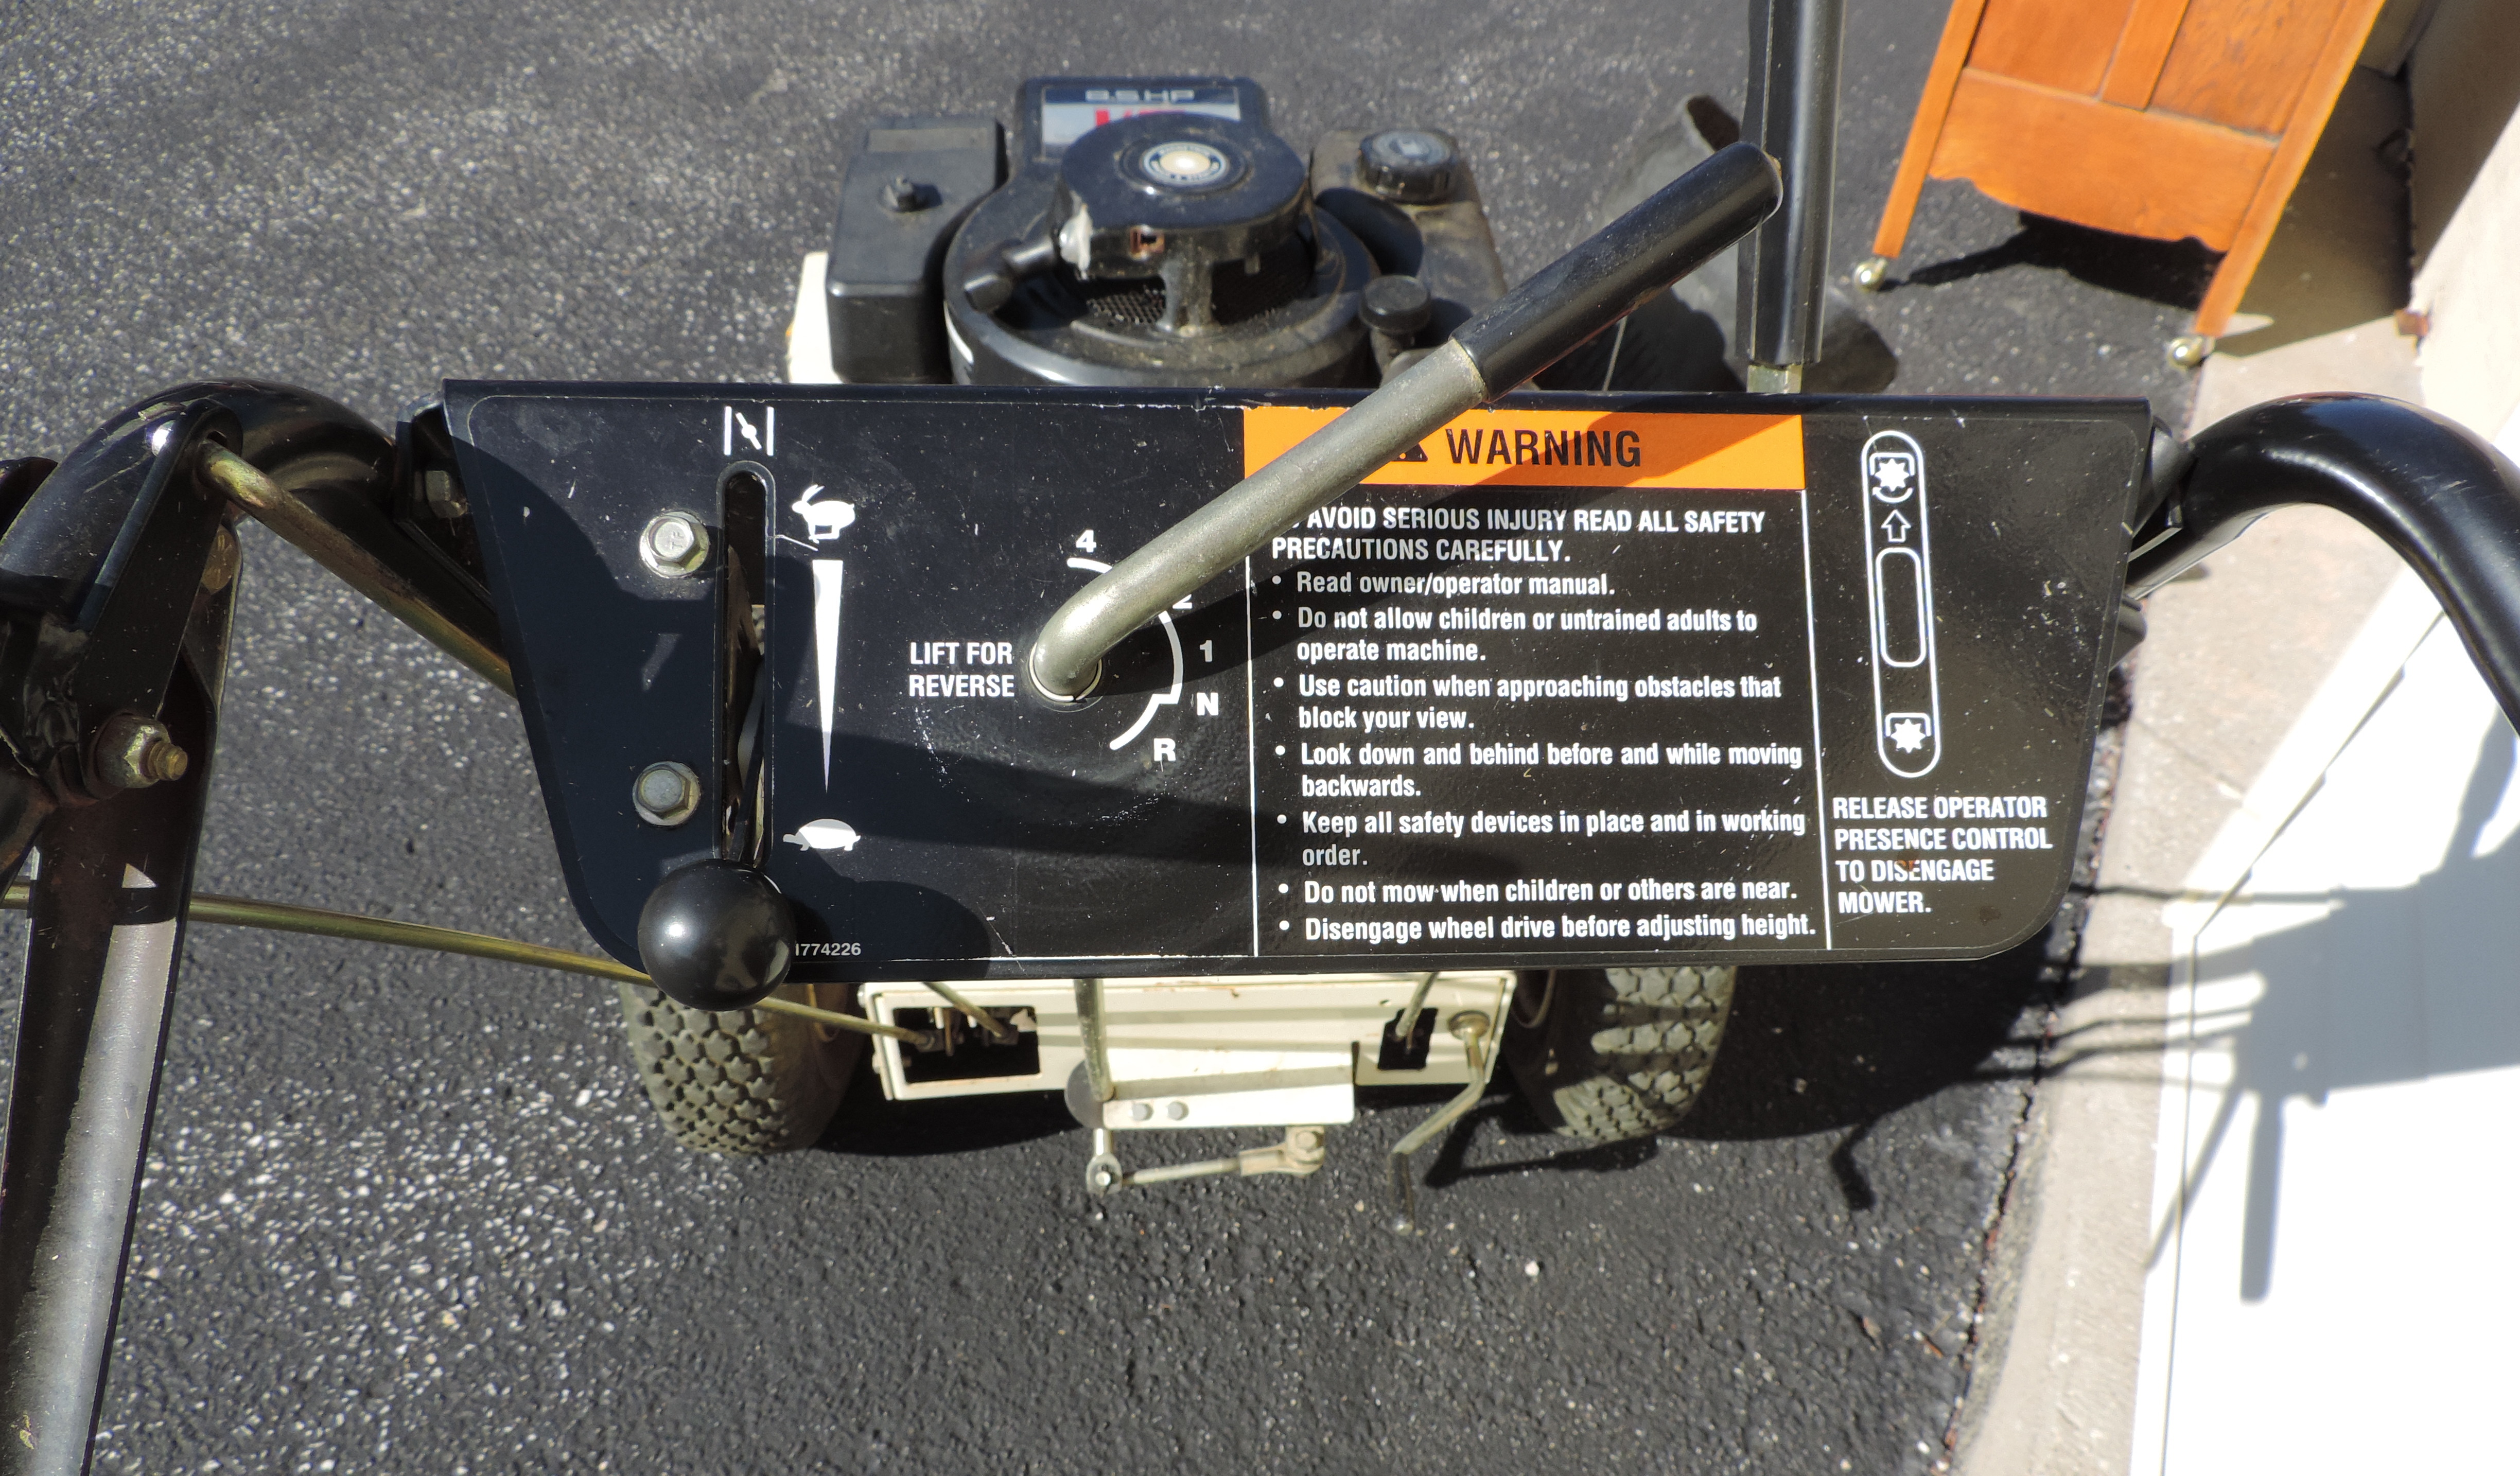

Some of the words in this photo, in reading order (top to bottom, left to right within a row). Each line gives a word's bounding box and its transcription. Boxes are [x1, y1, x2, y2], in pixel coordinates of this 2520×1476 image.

[1446, 429, 1640, 467] WARNING
[1307, 506, 1376, 529] AVOID
[1383, 506, 1479, 529] SERIOUS
[1487, 509, 1567, 531] INJURY
[1573, 509, 1632, 533] READ
[1636, 509, 1679, 533] ALL
[1684, 510, 1765, 533] SAFETY
[1075, 530, 1097, 553] 4
[1272, 536, 1428, 560] PRECAUTIONS
[1437, 539, 1570, 563] CAREFULLY.
[1298, 572, 1351, 592] Read
[1360, 573, 1522, 599] owner/operator
[1528, 573, 1615, 595] manual.
[1299, 607, 1326, 628] Do
[1334, 608, 1368, 629] not
[1374, 606, 1432, 630] allow
[1439, 607, 1526, 630] children
[1532, 612, 1554, 630] or
[1561, 608, 1661, 631] untrained
[1667, 608, 1732, 631] adults
[1736, 610, 1758, 632] to
[910, 641, 960, 666] LIFT
[966, 641, 1014, 665] FOR
[1200, 640, 1212, 662] 1
[1297, 639, 1379, 665] operate
[1386, 638, 1485, 661] machine.
[908, 673, 1014, 698] REVERSE
[1299, 673, 1340, 697] Use
[1347, 674, 1426, 697] caution
[1432, 674, 1490, 697] when
[1497, 675, 1629, 702] approaching
[1634, 675, 1736, 698] obstacles
[1740, 676, 1782, 698] that
[1196, 692, 1220, 717] N
[1297, 706, 1357, 729] block
[1362, 711, 1411, 733] your
[1416, 706, 1474, 729] view.
[1153, 737, 1177, 762] R
[1301, 742, 1351, 765] Look
[1359, 743, 1414, 765] down
[1423, 743, 1461, 765] and
[1469, 742, 1539, 765] behind
[1547, 743, 1613, 765] before
[1621, 743, 1659, 765] and
[1666, 743, 1721, 765] while
[1728, 743, 1802, 769] moving
[1301, 774, 1421, 797] backwards.
[1832, 796, 1928, 819] RELEASE
[1933, 796, 2047, 819] OPERATOR
[1303, 811, 1357, 837] Keep
[1364, 811, 1392, 833] all
[1399, 811, 1464, 838] safety
[1471, 811, 1553, 833] devices
[1560, 810, 1580, 833] in
[1586, 809, 1644, 837] place
[1650, 810, 1690, 832] and
[1696, 810, 1717, 832] in
[1721, 809, 1806, 837] working
[1834, 827, 1948, 852] PRESENCE
[1951, 827, 2054, 851] CONTROL
[1303, 844, 1367, 866] order.
[1834, 859, 1866, 884] TO
[1870, 858, 1995, 883] DISENGAGE
[1305, 881, 1334, 904] Do
[1341, 881, 1376, 903] not
[1381, 885, 1434, 903] mow
[1440, 880, 1499, 902] when
[1506, 878, 1593, 902] children
[1600, 883, 1622, 901] or
[1628, 878, 1696, 901] others
[1701, 882, 1736, 900] are
[1742, 881, 1797, 900] near.
[1838, 891, 1932, 913] MOWER.
[1306, 918, 1422, 944] Disengage
[1428, 916, 1494, 939] wheel
[1501, 916, 1555, 938] drive
[1562, 915, 1631, 937] before
[1637, 914, 1736, 941] adjusting
[1741, 913, 1816, 940] height.
[795, 942, 862, 956] 1774226
